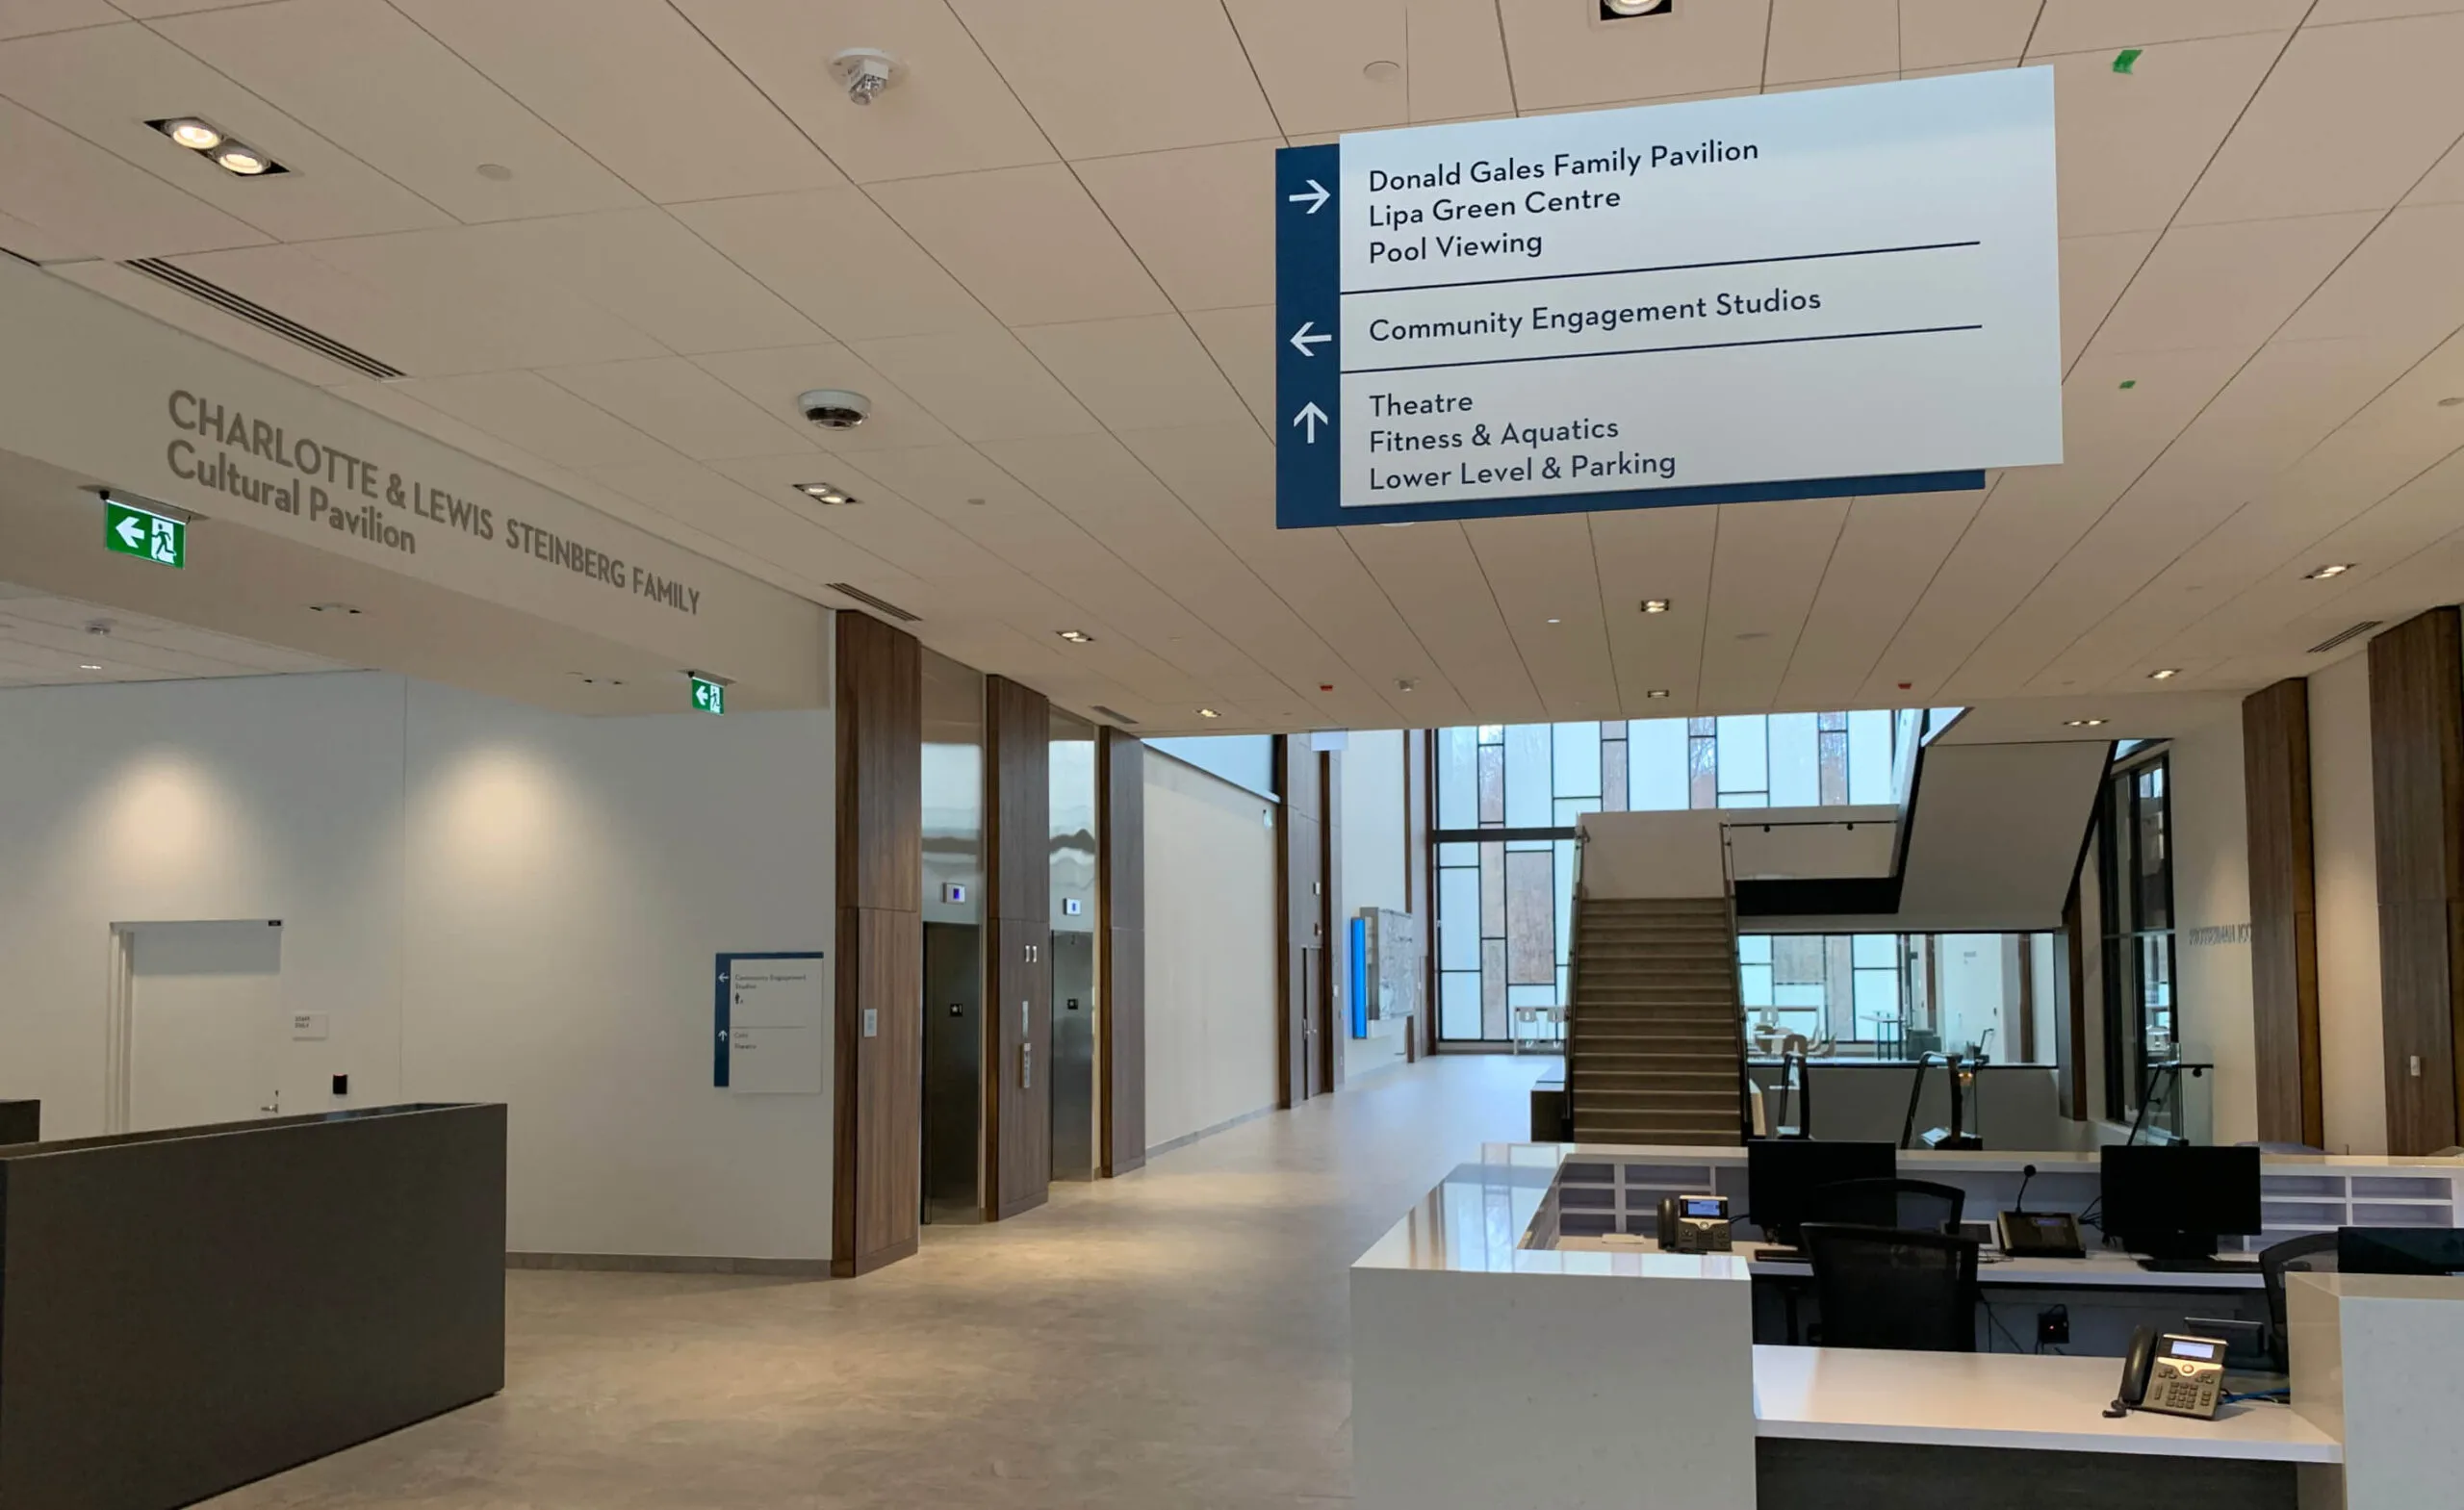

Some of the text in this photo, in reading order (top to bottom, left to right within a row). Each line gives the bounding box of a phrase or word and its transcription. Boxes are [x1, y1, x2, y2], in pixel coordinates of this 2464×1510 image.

[1370, 139, 1759, 192] Donald Gales Family Pavilion
[1370, 190, 1622, 233] Lipa Green Centre
[1370, 232, 1543, 265] Pool Viewing
[1369, 287, 1822, 343] Community Engagement Studios
[1369, 393, 1474, 418] Theatre
[1370, 418, 1620, 454] Fitness & Aquatics
[1370, 450, 1677, 492] Lower Level & Parking
[167, 439, 416, 555] Cultural Pavilion
[167, 389, 701, 616] CHARLOTTE & LEWIS STEINBERG FAMILY
